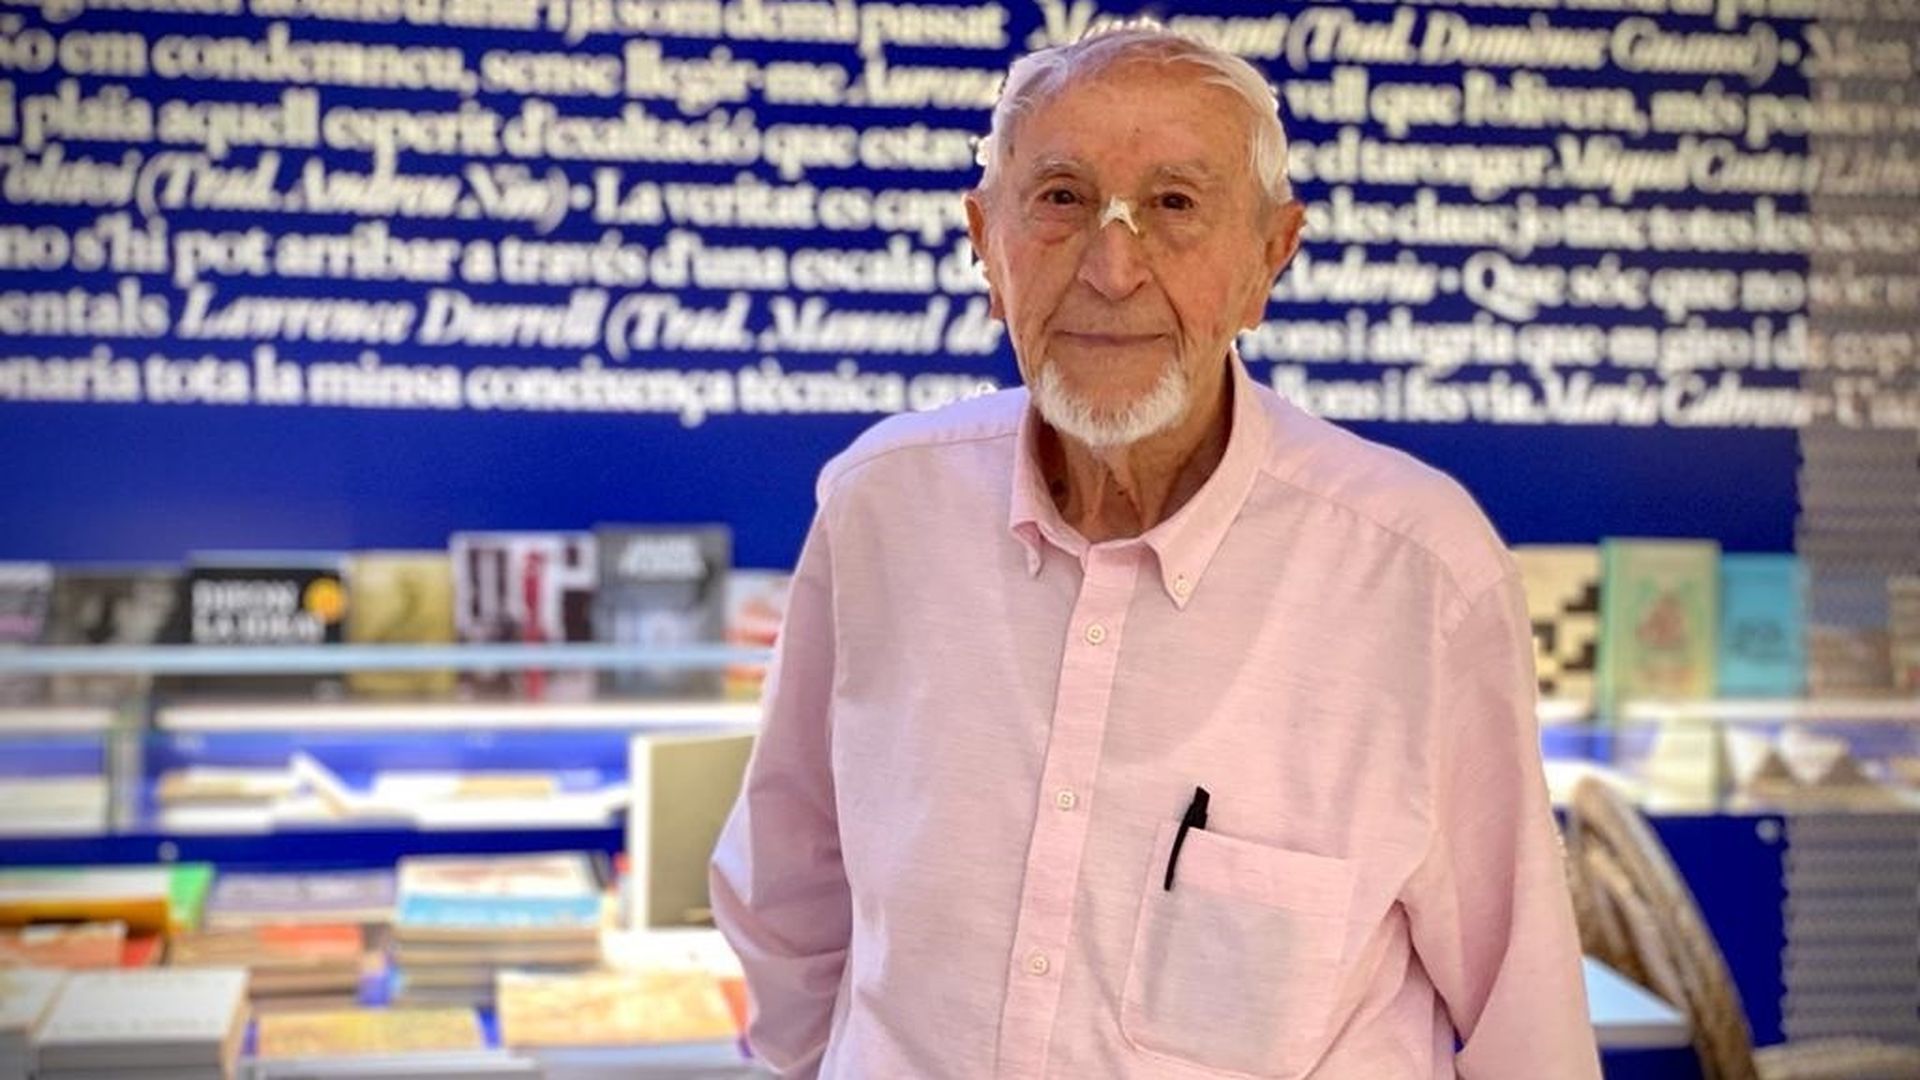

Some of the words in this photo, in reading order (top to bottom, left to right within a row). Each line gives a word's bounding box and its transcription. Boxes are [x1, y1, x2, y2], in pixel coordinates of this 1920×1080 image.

[157, 88, 320, 159] aquell
[764, 124, 859, 181] que
[594, 167, 664, 225] La
[172, 227, 272, 288] pot
[274, 220, 460, 282] arribar
[461, 240, 497, 284] a
[0, 344, 140, 404] naria
[144, 353, 251, 406] tota
[253, 344, 305, 407] la
